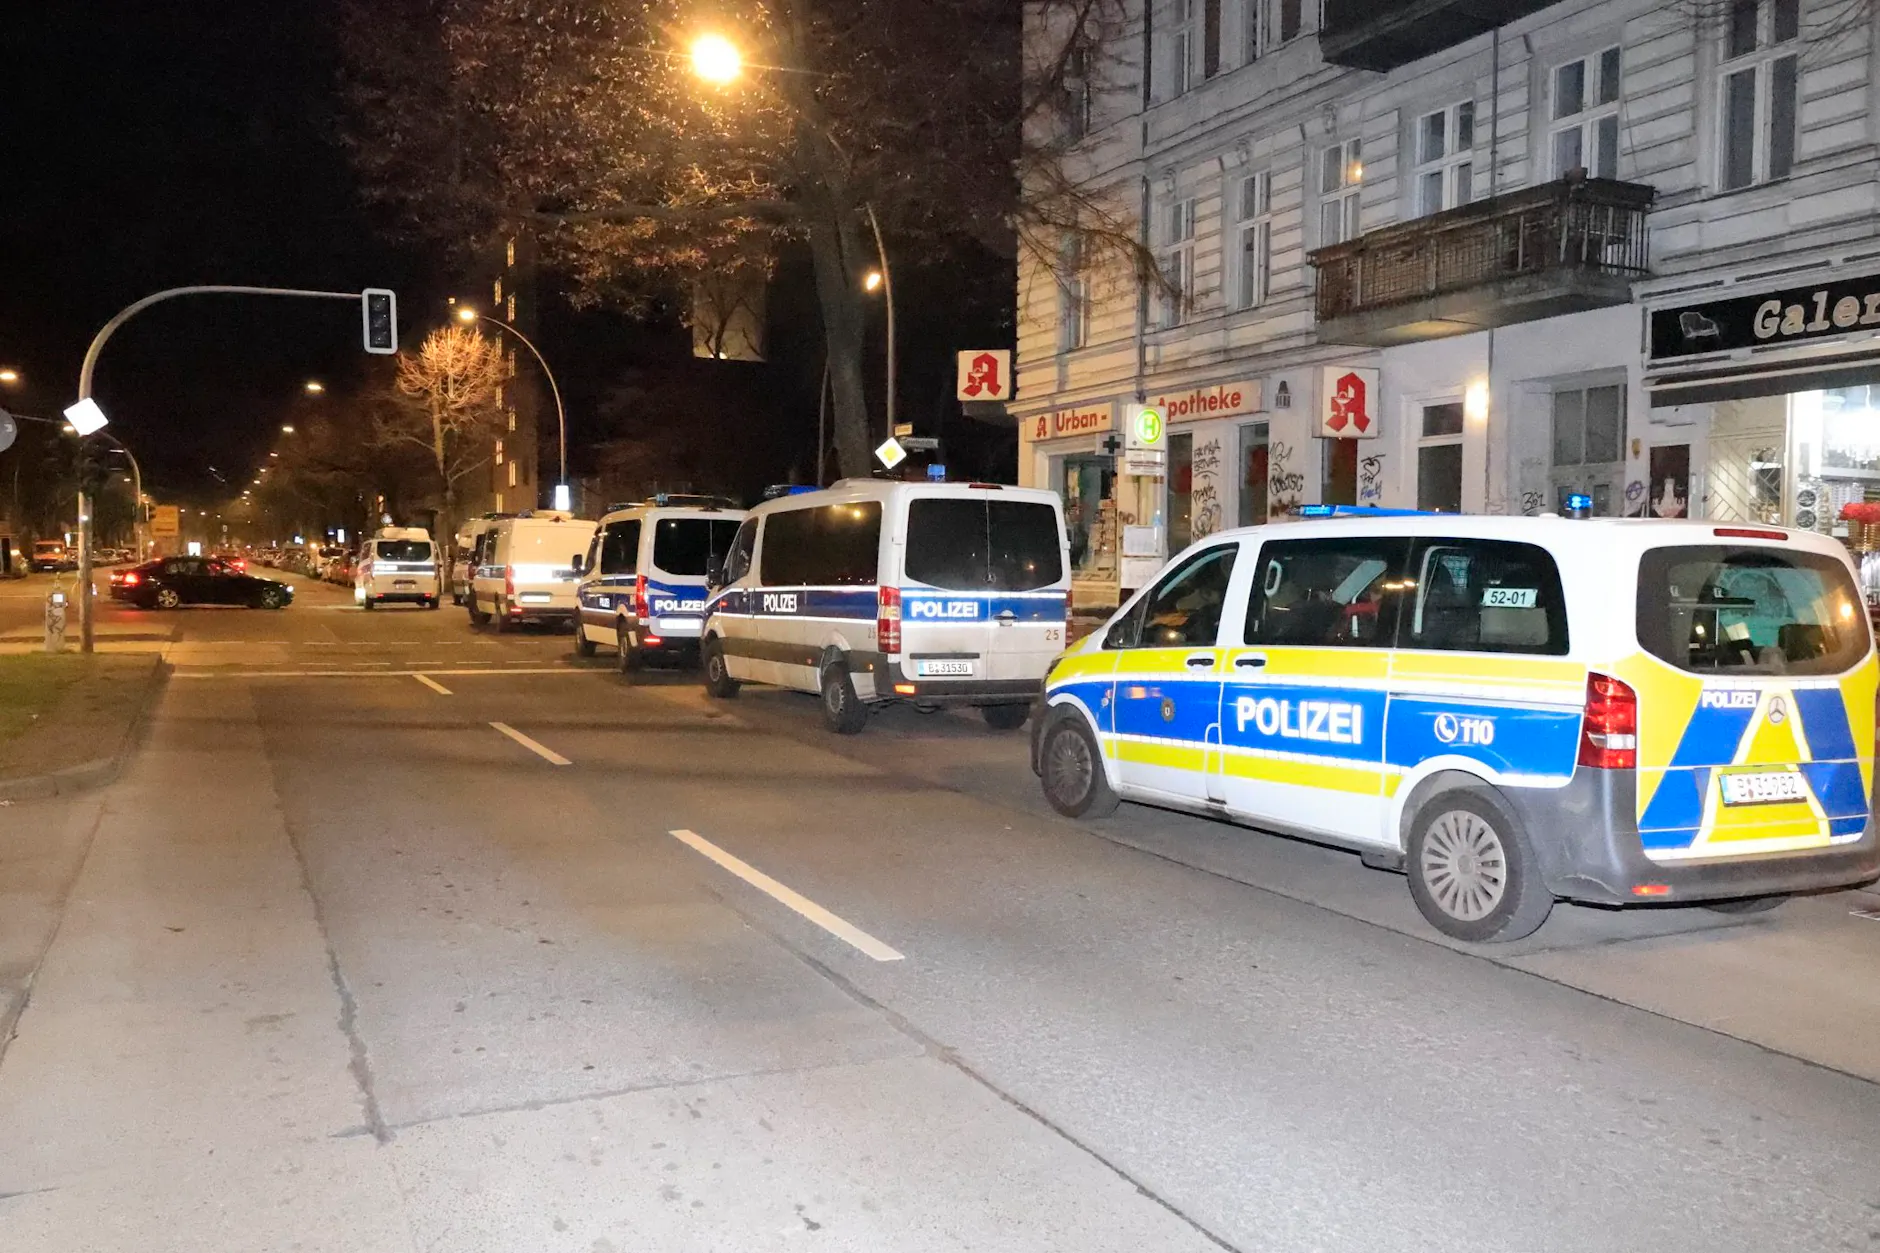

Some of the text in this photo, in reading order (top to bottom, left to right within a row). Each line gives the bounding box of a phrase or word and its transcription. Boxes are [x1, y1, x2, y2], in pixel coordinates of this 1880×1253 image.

[655, 600, 706, 612] POLIZEI
[763, 594, 798, 612] POLIZEI
[1489, 590, 1527, 605] 52-01
[911, 601, 978, 618] POLIZEI
[1045, 629, 1060, 640] 25
[1701, 690, 1757, 708] POLIZEI
[1237, 697, 1363, 744] POLIZEI
[1460, 718, 1495, 745] 110
